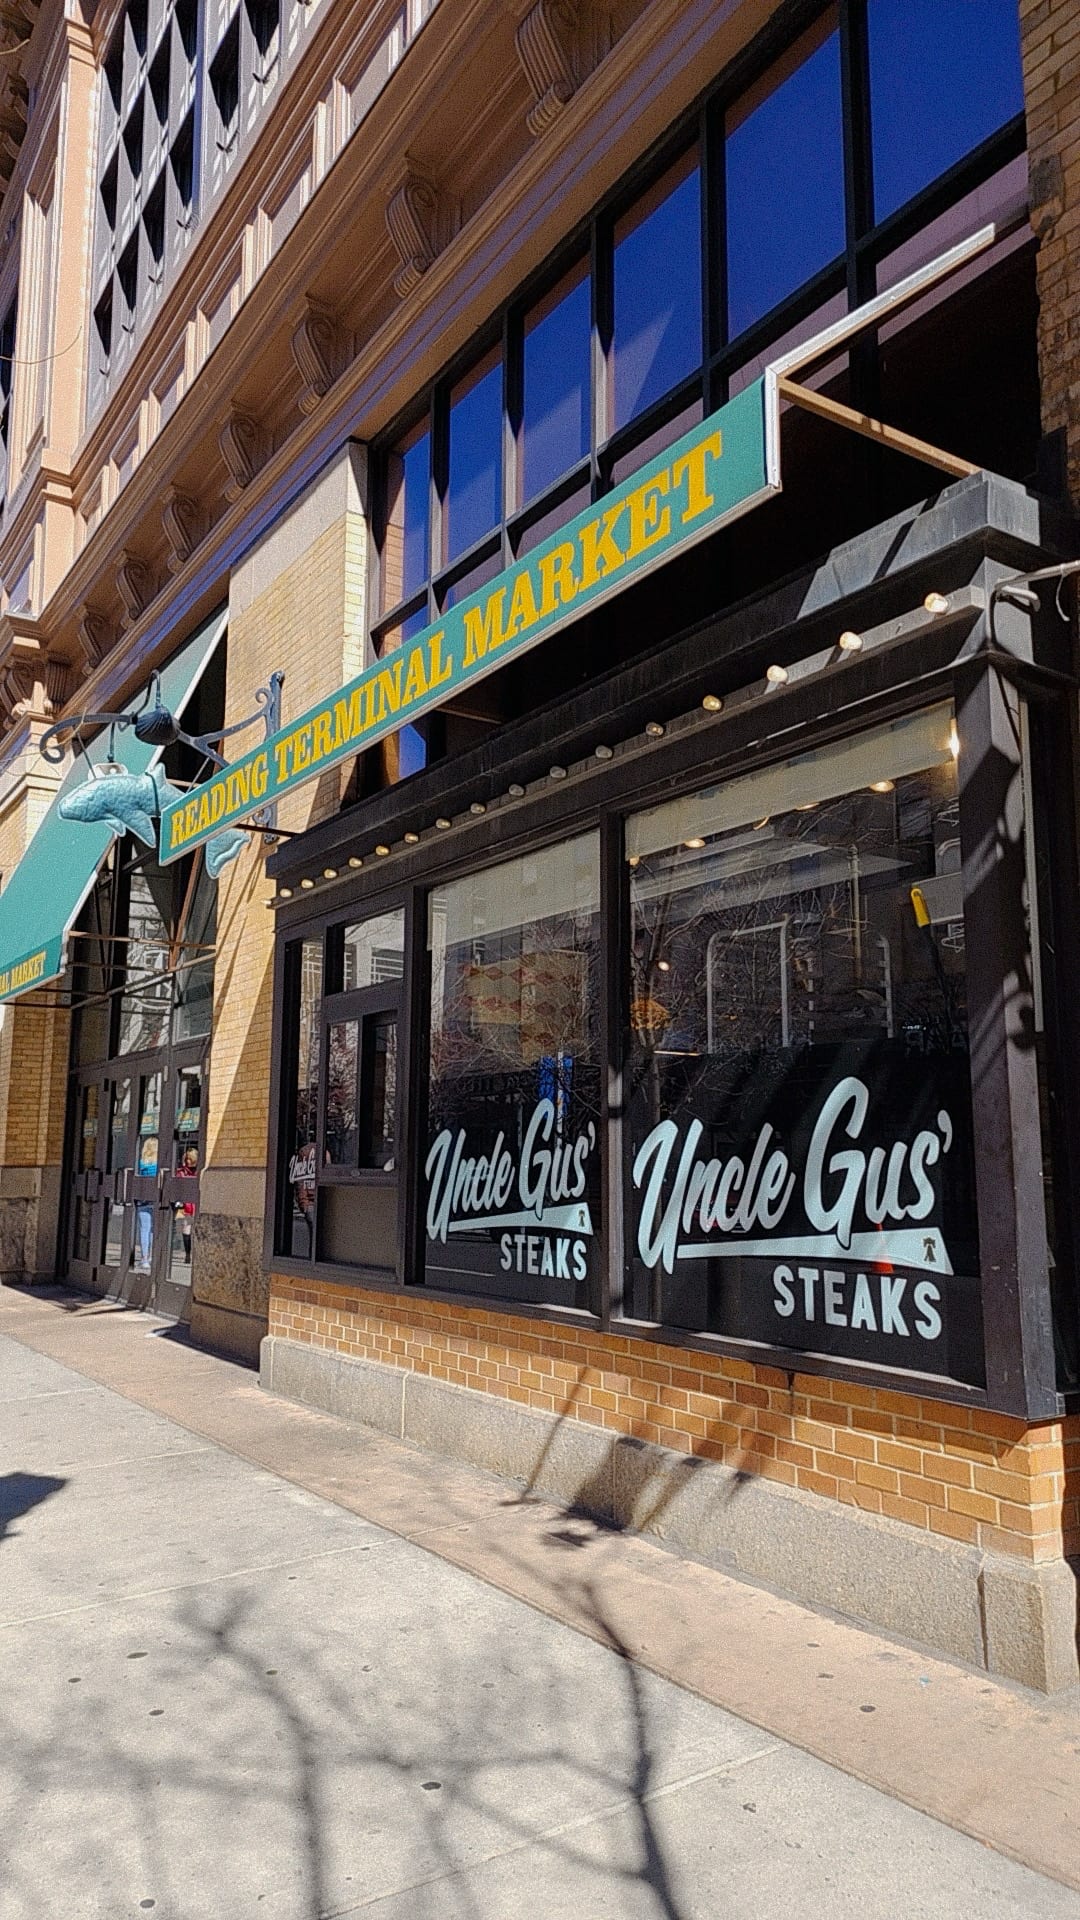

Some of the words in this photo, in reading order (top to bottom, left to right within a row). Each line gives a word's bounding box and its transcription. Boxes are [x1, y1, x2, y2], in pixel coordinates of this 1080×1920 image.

[170, 752, 270, 850] READING
[275, 630, 453, 785] TERMINAL
[462, 429, 723, 669] MARKET
[11, 951, 46, 991] MARKET
[425, 1128, 516, 1245] Uncle
[519, 1097, 596, 1221] Gus'
[633, 1118, 796, 1275] Uncle
[804, 1076, 953, 1250] Gus'
[500, 1232, 588, 1281] STEAKS
[773, 1264, 942, 1340] STEAKS
